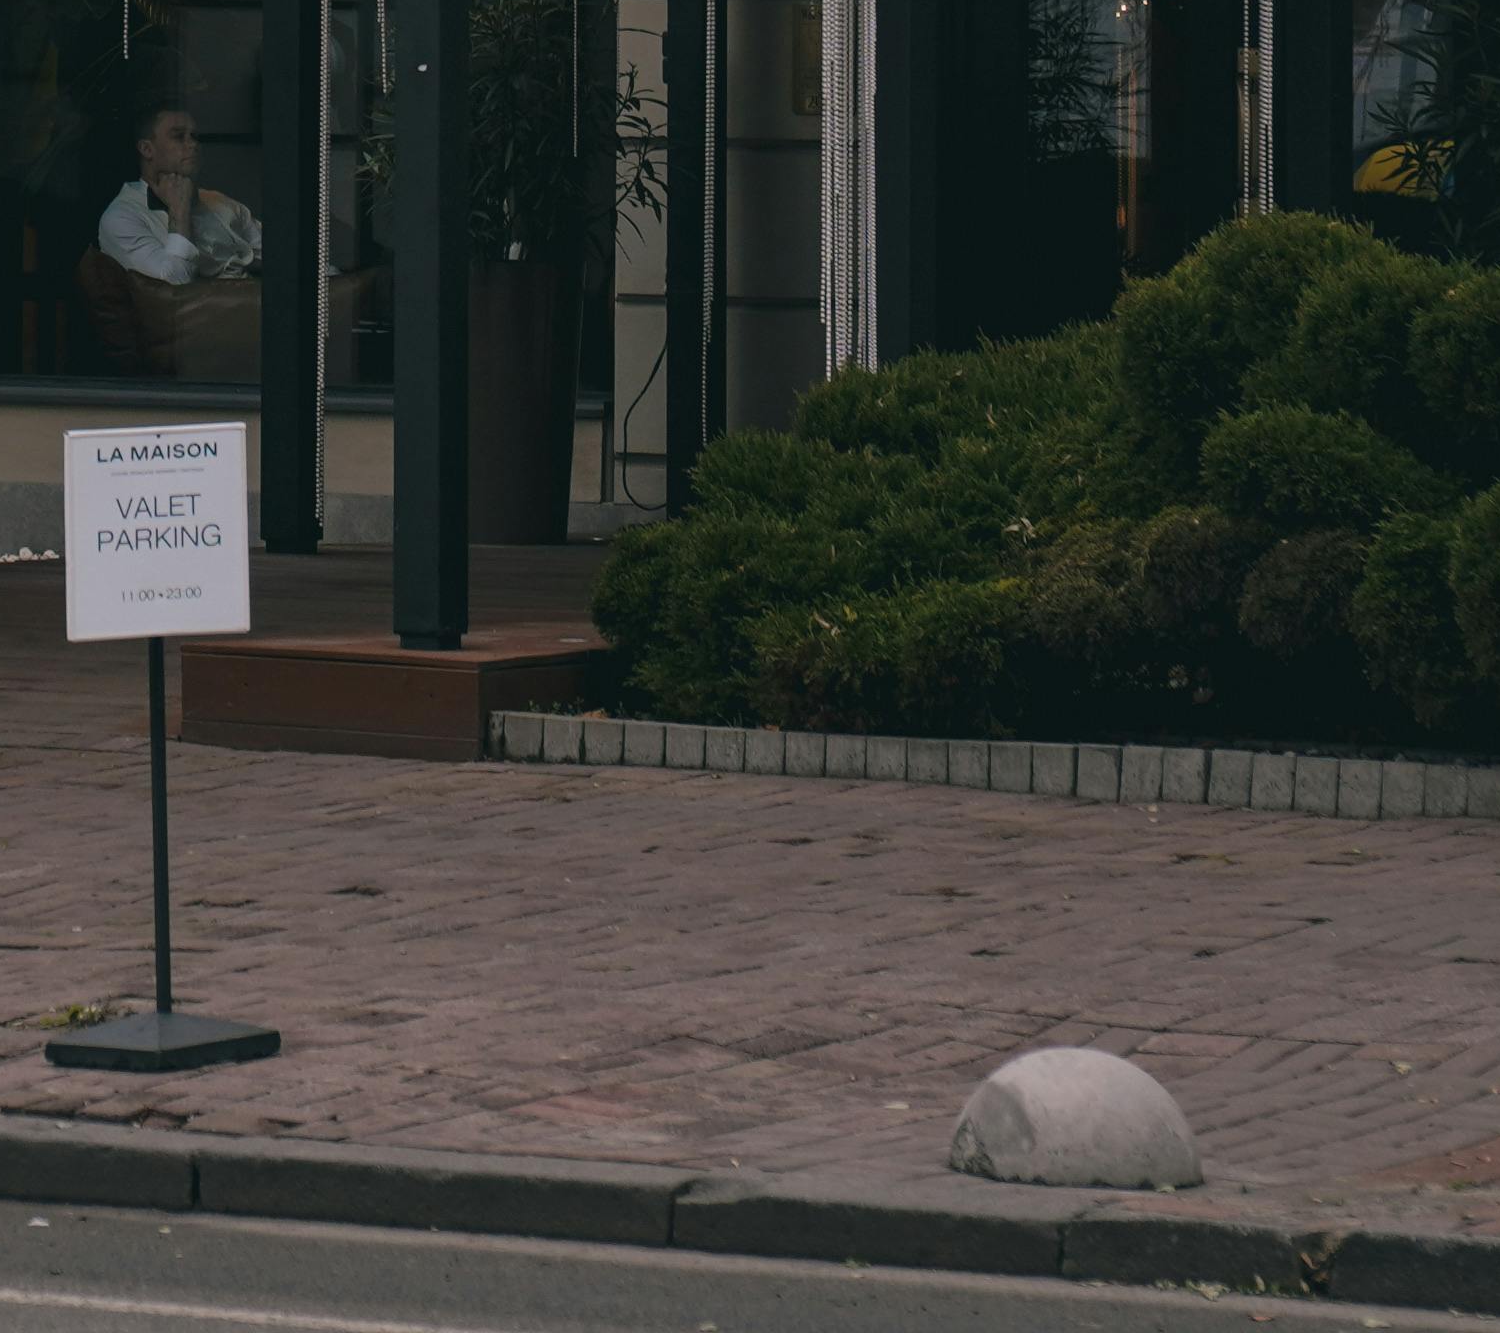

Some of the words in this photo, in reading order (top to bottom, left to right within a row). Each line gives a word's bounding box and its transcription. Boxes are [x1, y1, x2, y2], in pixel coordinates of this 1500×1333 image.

[96, 447, 123, 463] LA
[131, 442, 217, 461] MAISON
[115, 493, 202, 520] VALET
[97, 523, 222, 553] PARKING
